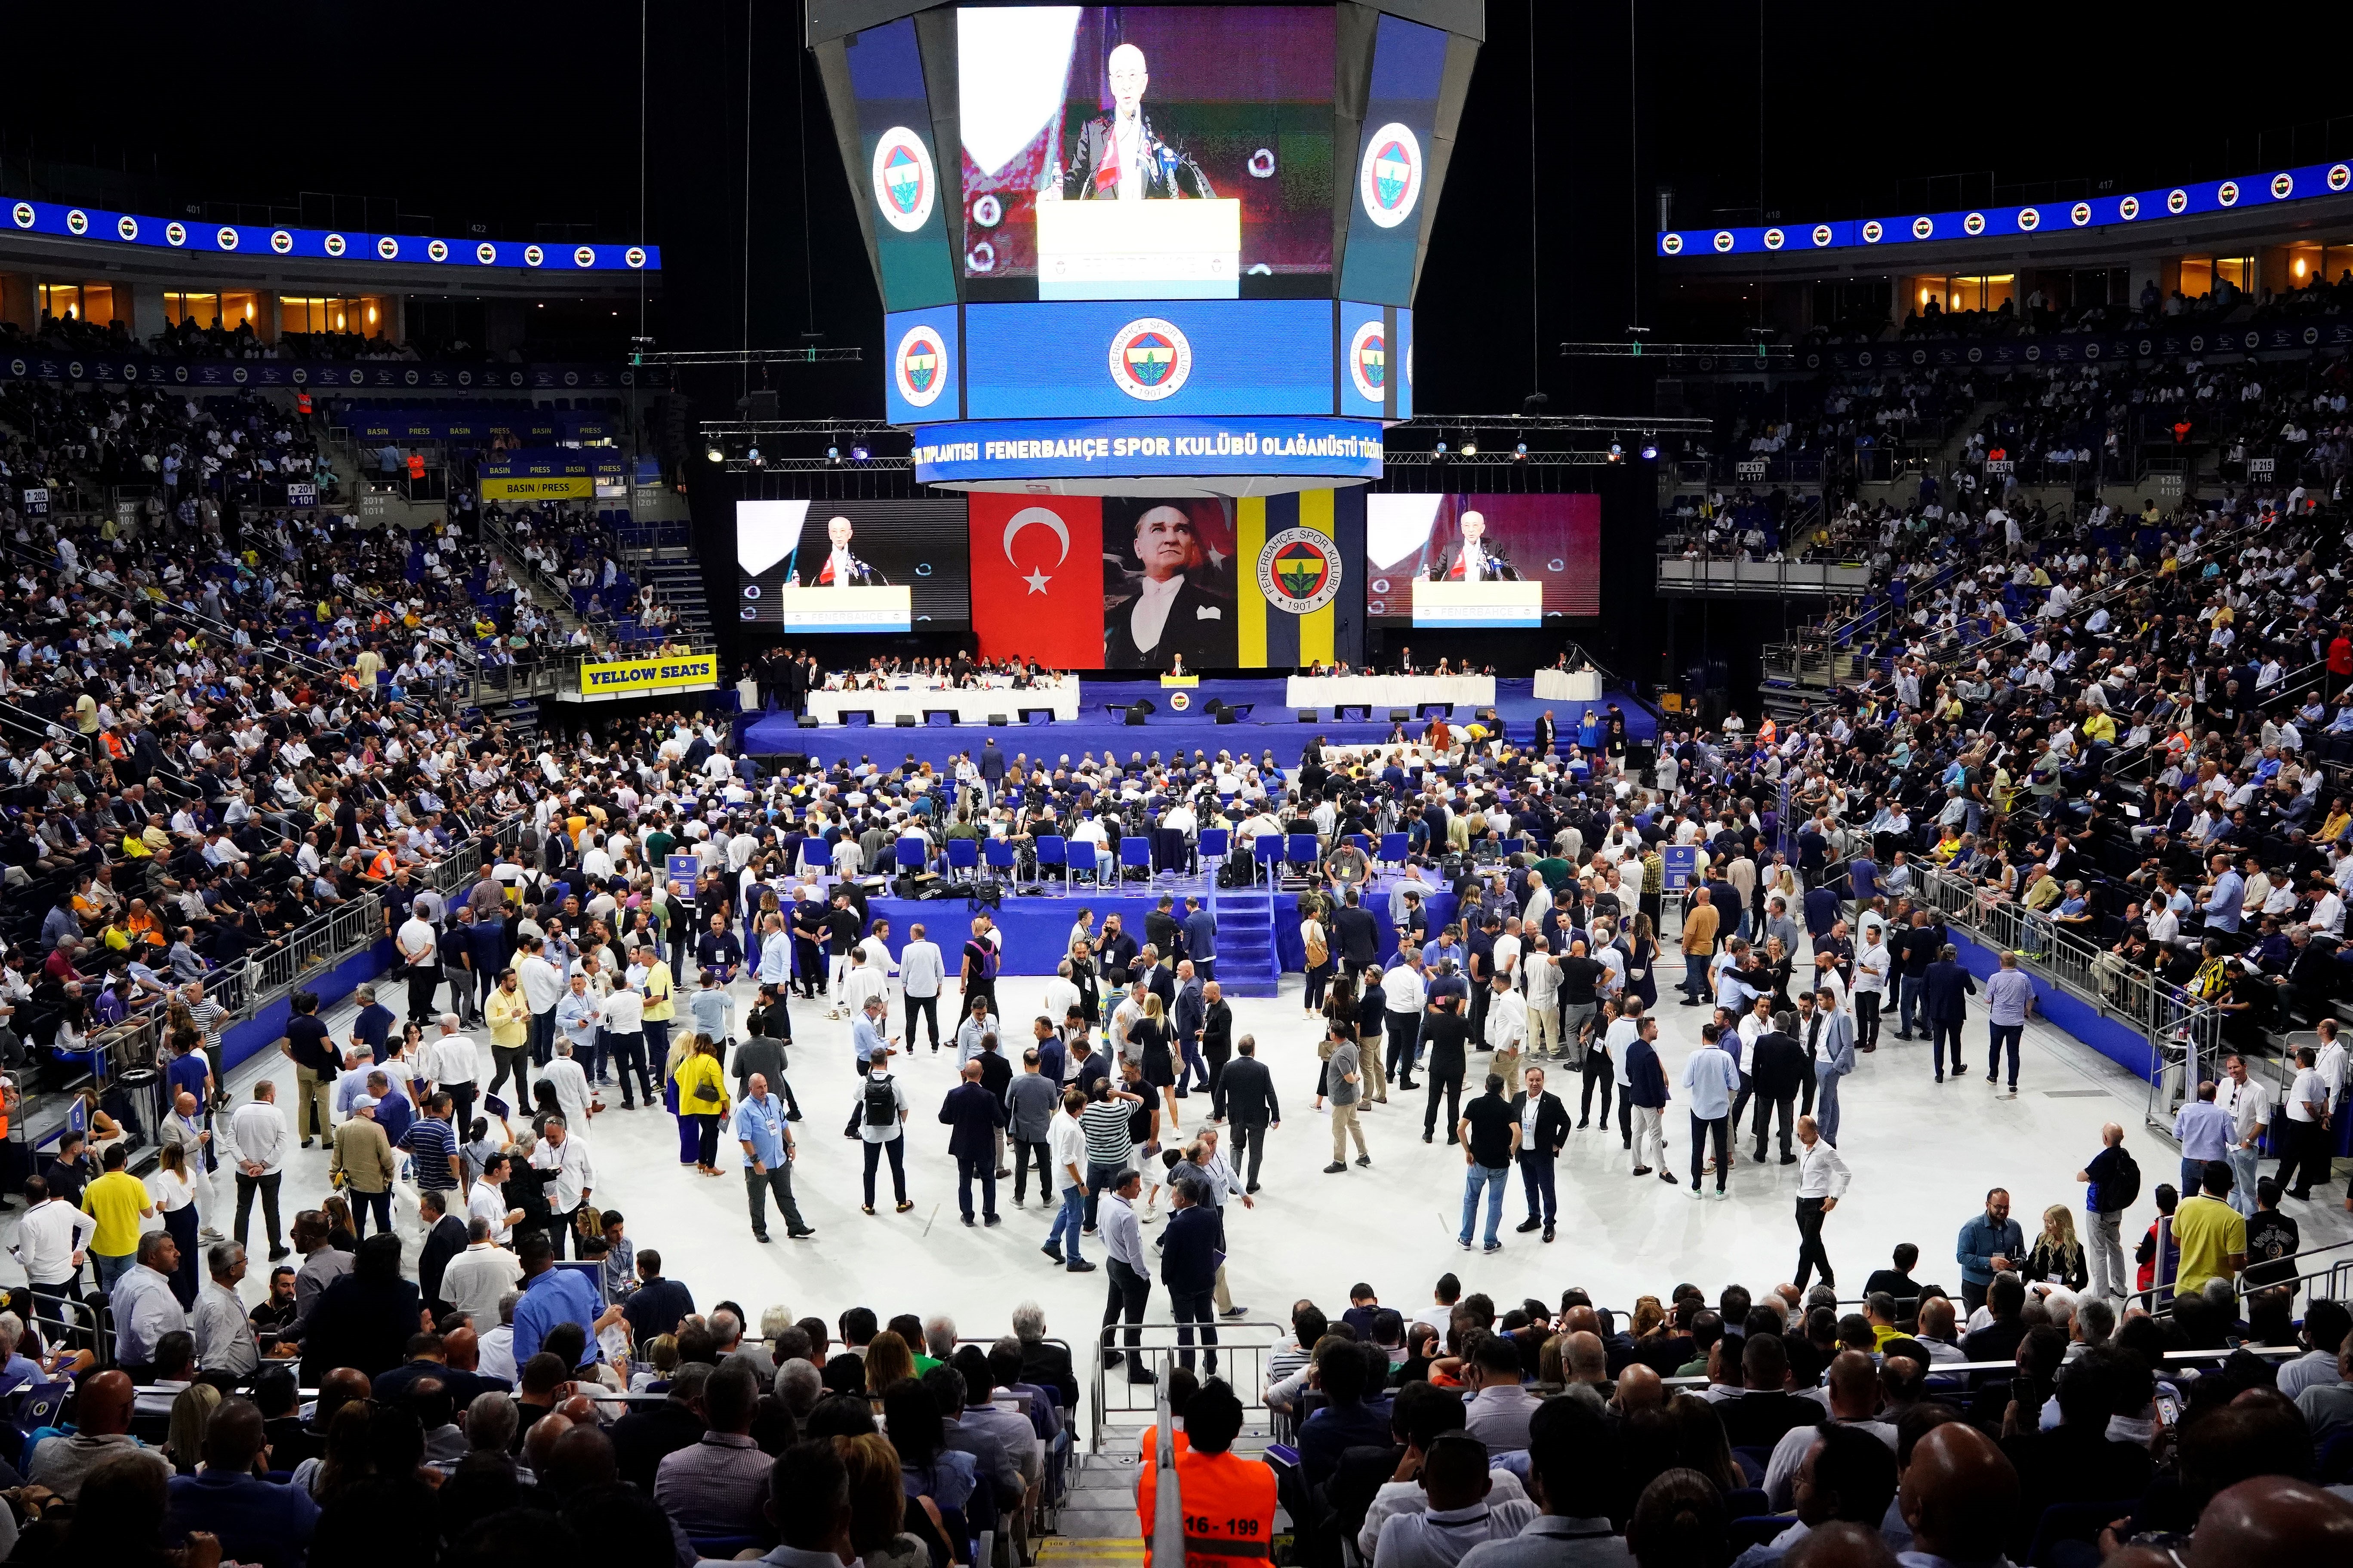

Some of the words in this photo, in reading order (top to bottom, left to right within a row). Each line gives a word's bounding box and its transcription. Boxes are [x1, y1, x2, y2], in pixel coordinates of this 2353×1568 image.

[187, 205, 200, 215] 401
[471, 224, 487, 233] 422
[1149, 321, 1177, 338] SPOR
[1139, 388, 1161, 397] 1907
[923, 443, 978, 464] TOPLANTISI
[986, 440, 1109, 461] FENERBAHÇE
[1112, 437, 1170, 456] SPOR
[1174, 432, 1257, 456] KULÜBÜ
[1261, 433, 1357, 458] OLAĞANÜSTÜ
[1996, 463, 2011, 471] 216
[2259, 461, 2272, 470] 215
[1996, 473, 2005, 482] 11
[2259, 473, 2272, 482] 115
[299, 486, 314, 494] 201
[507, 484, 535, 493] BASIN
[536, 484, 541, 494] /
[542, 483, 570, 492] PRESS
[34, 492, 46, 501] 202
[299, 496, 314, 504] 101
[34, 503, 47, 513] 102
[1260, 531, 1295, 595] FENERBAHÇE
[1299, 530, 1328, 549] SPOR
[1326, 550, 1341, 594] KULÜBÜ
[1288, 601, 1311, 611] 1907
[589, 667, 657, 685] YELLOW
[661, 663, 709, 679] SEATS
[1186, 1516, 1209, 1533] 16
[1226, 1518, 1259, 1537] 199
